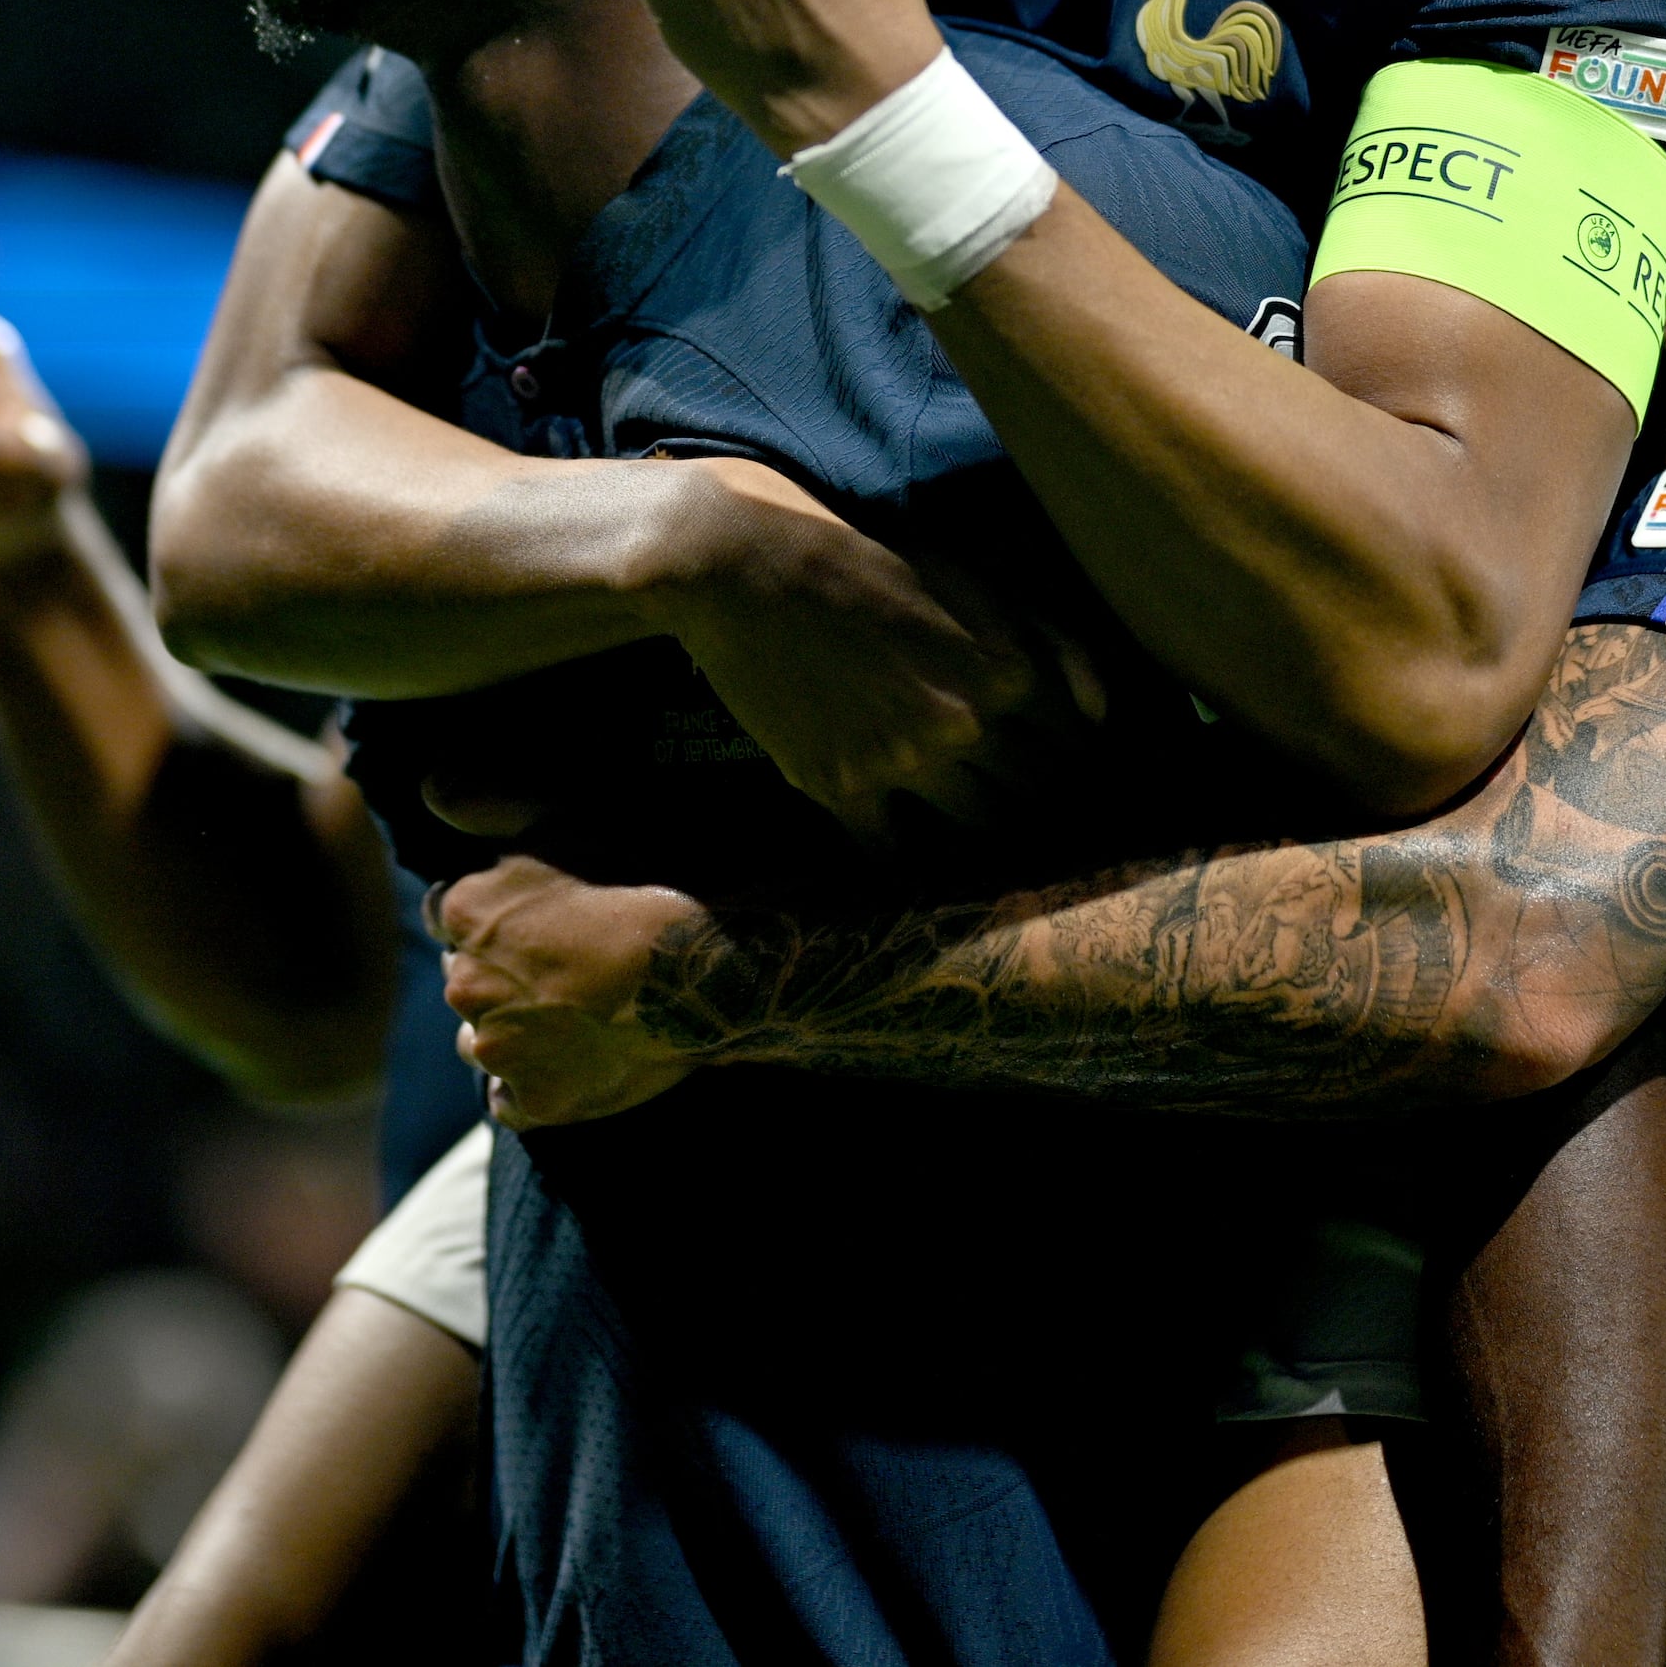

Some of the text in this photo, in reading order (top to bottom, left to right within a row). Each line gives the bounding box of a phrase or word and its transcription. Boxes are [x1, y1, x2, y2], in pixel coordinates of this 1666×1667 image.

[1556, 27, 1623, 56] UEFA
[1335, 141, 1515, 201] ESPECT
[1590, 217, 1615, 238] UEFA
